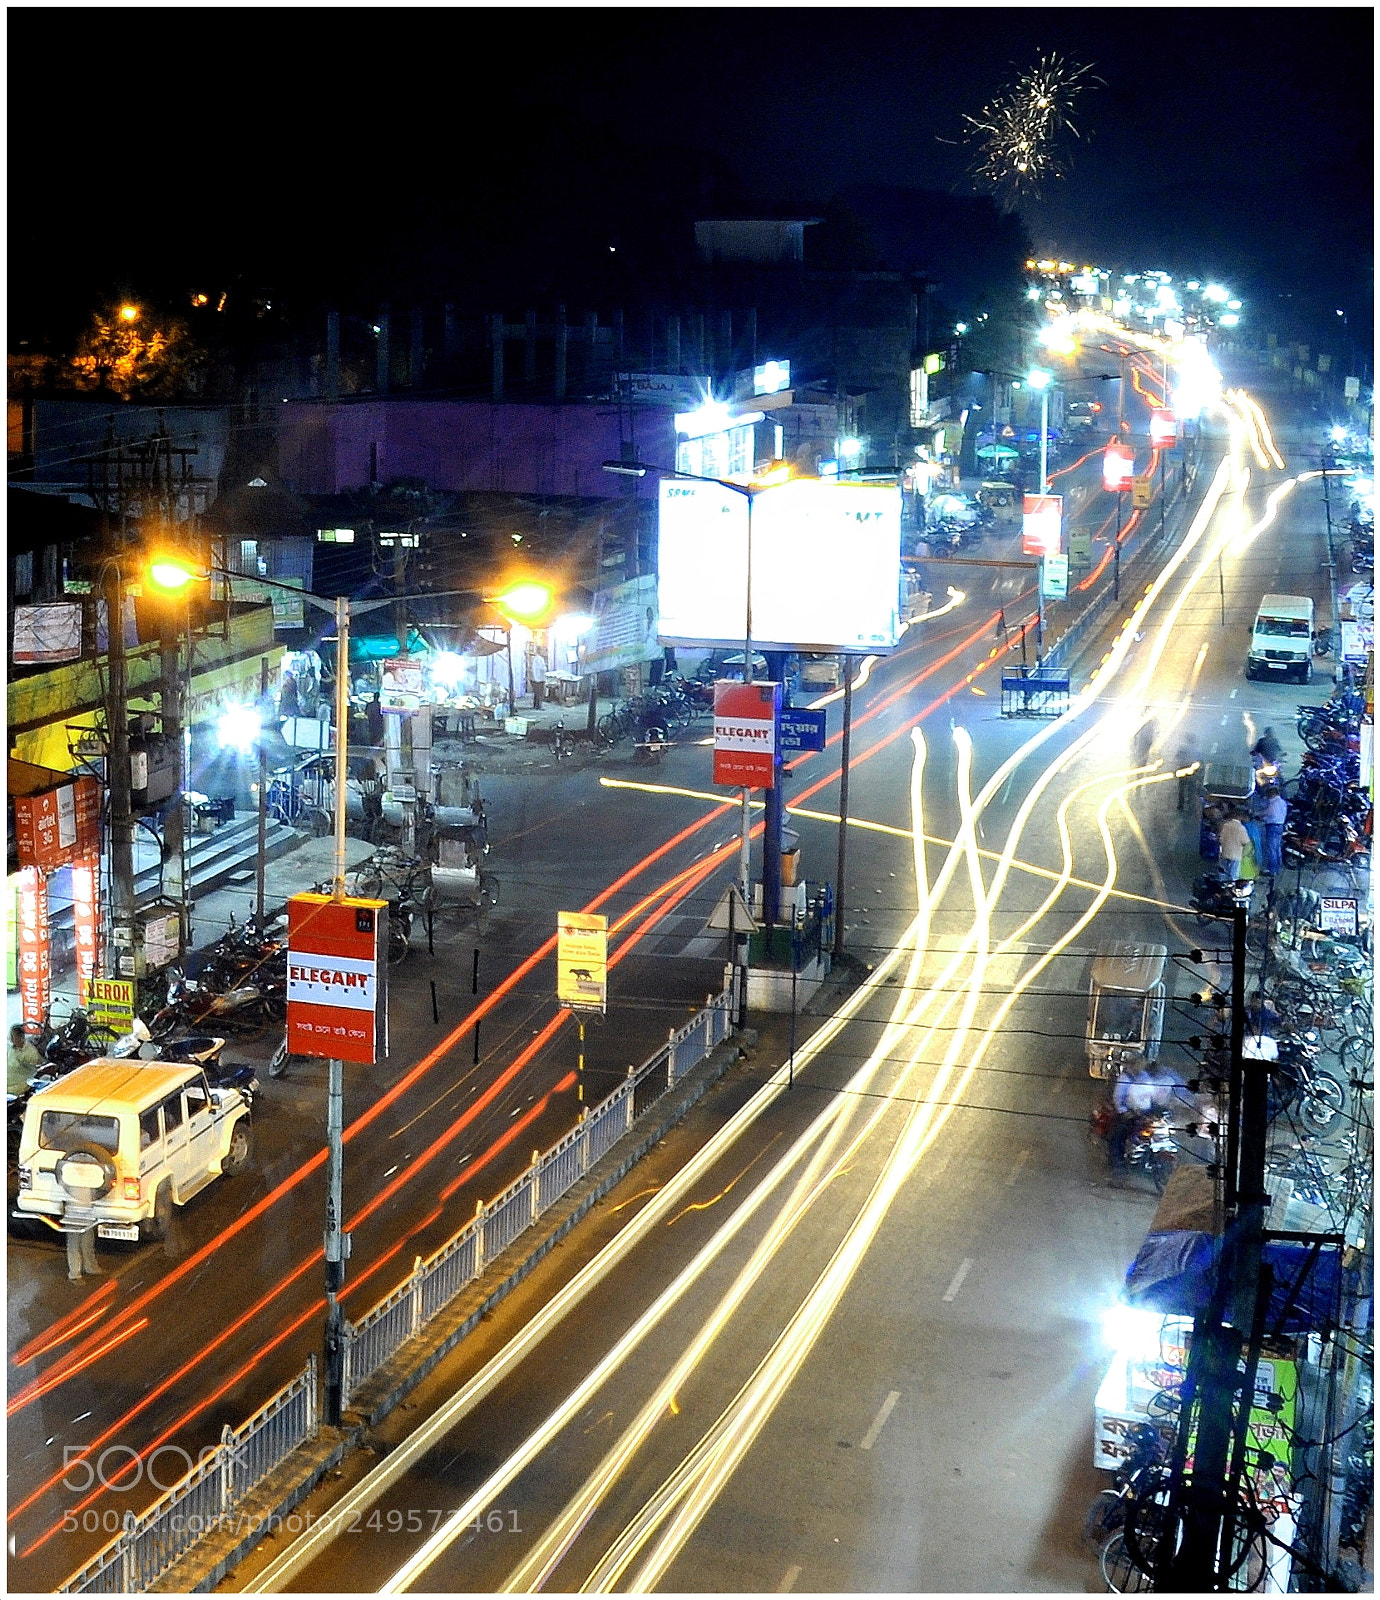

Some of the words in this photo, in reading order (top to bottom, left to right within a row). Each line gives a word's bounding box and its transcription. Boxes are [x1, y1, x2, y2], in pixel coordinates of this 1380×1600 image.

[716, 726, 768, 739] ELEGANT
[38, 812, 56, 831] airtel
[43, 829, 53, 845] 3G
[1324, 900, 1355, 910] SILPA
[23, 951, 38, 972] 3G
[80, 951, 94, 979] irtel
[290, 967, 368, 988] ELEGANT
[24, 978, 38, 1015] airtel
[88, 982, 130, 1001] XEROX
